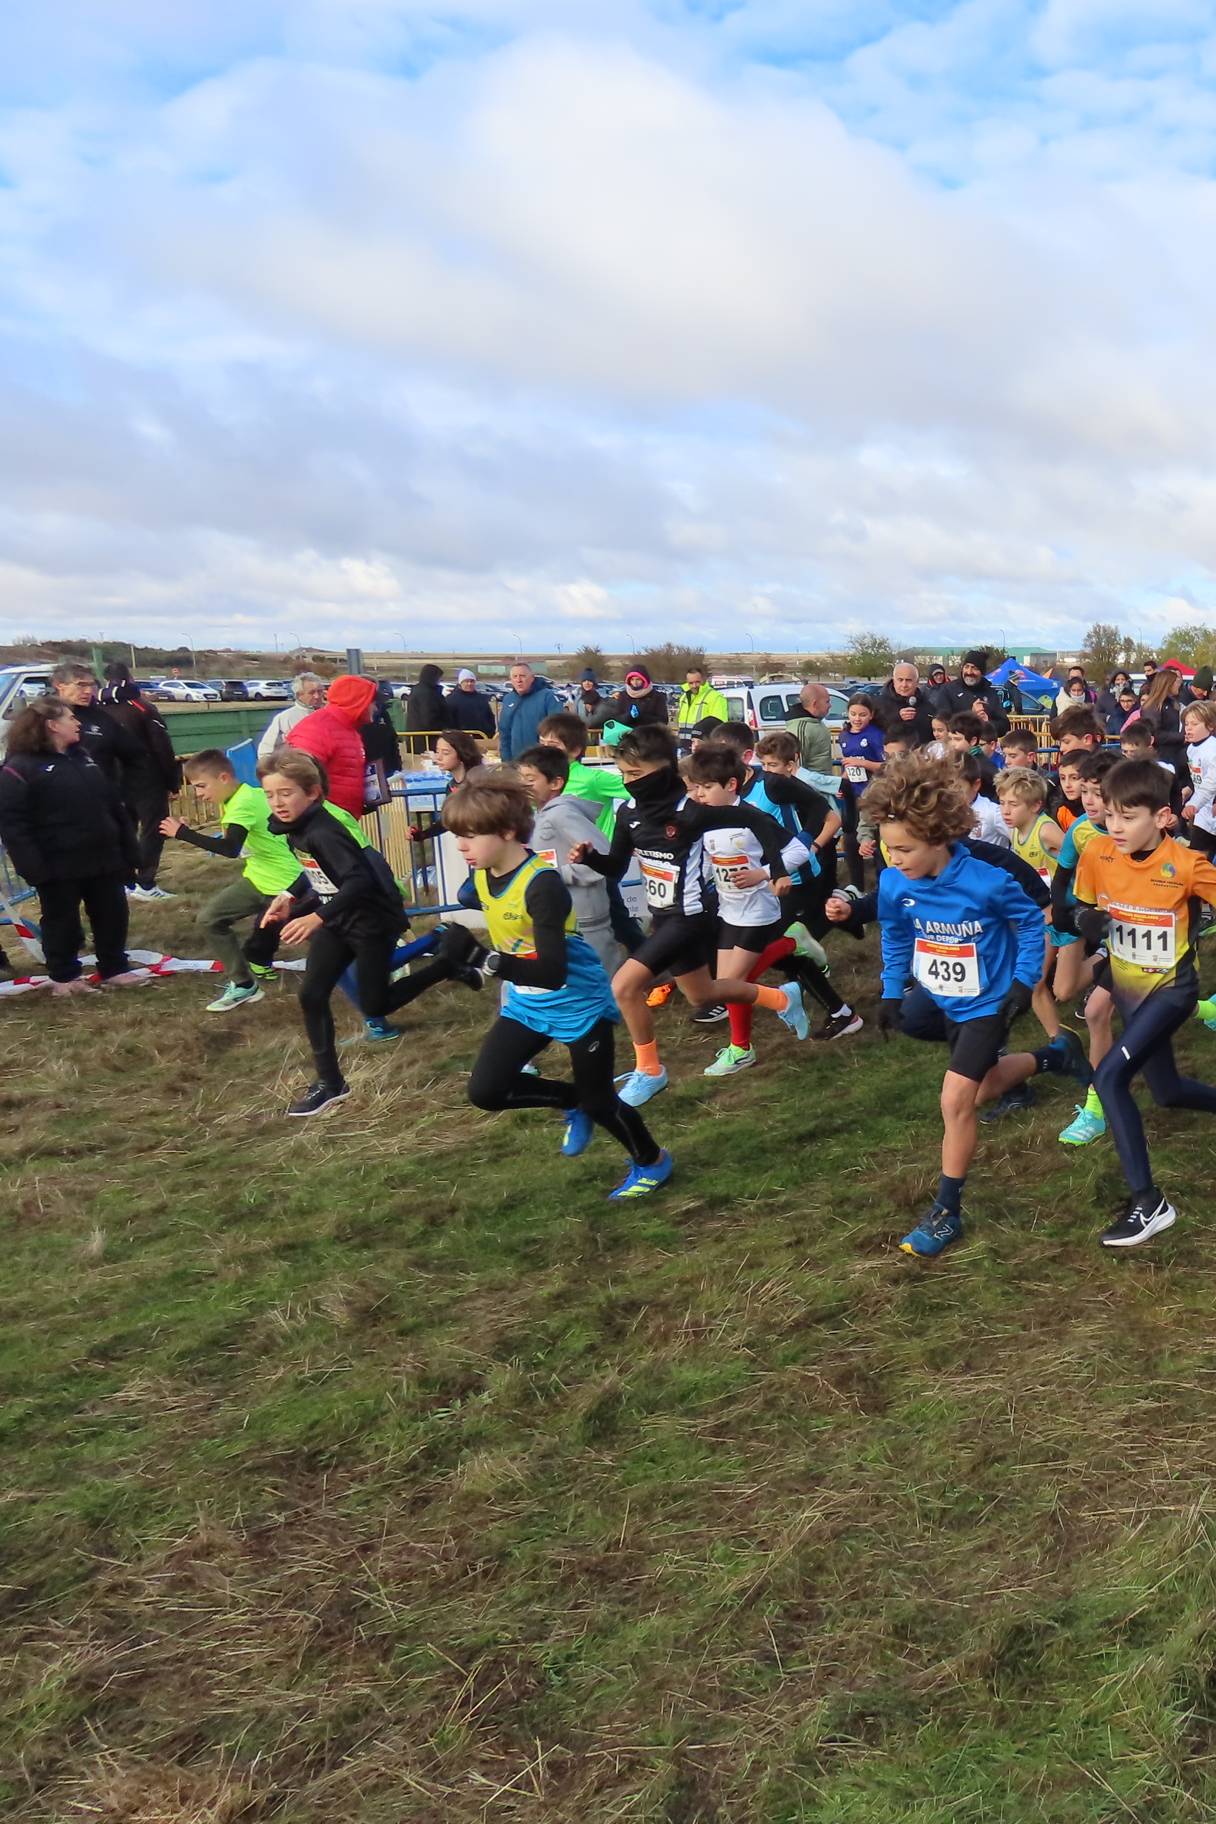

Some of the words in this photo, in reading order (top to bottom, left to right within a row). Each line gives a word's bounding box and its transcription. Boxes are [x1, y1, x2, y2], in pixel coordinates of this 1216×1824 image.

[645, 879, 667, 898] 60
[926, 920, 983, 937] ARMUÑA
[1115, 924, 1168, 951] 1111
[928, 959, 966, 983] 439
